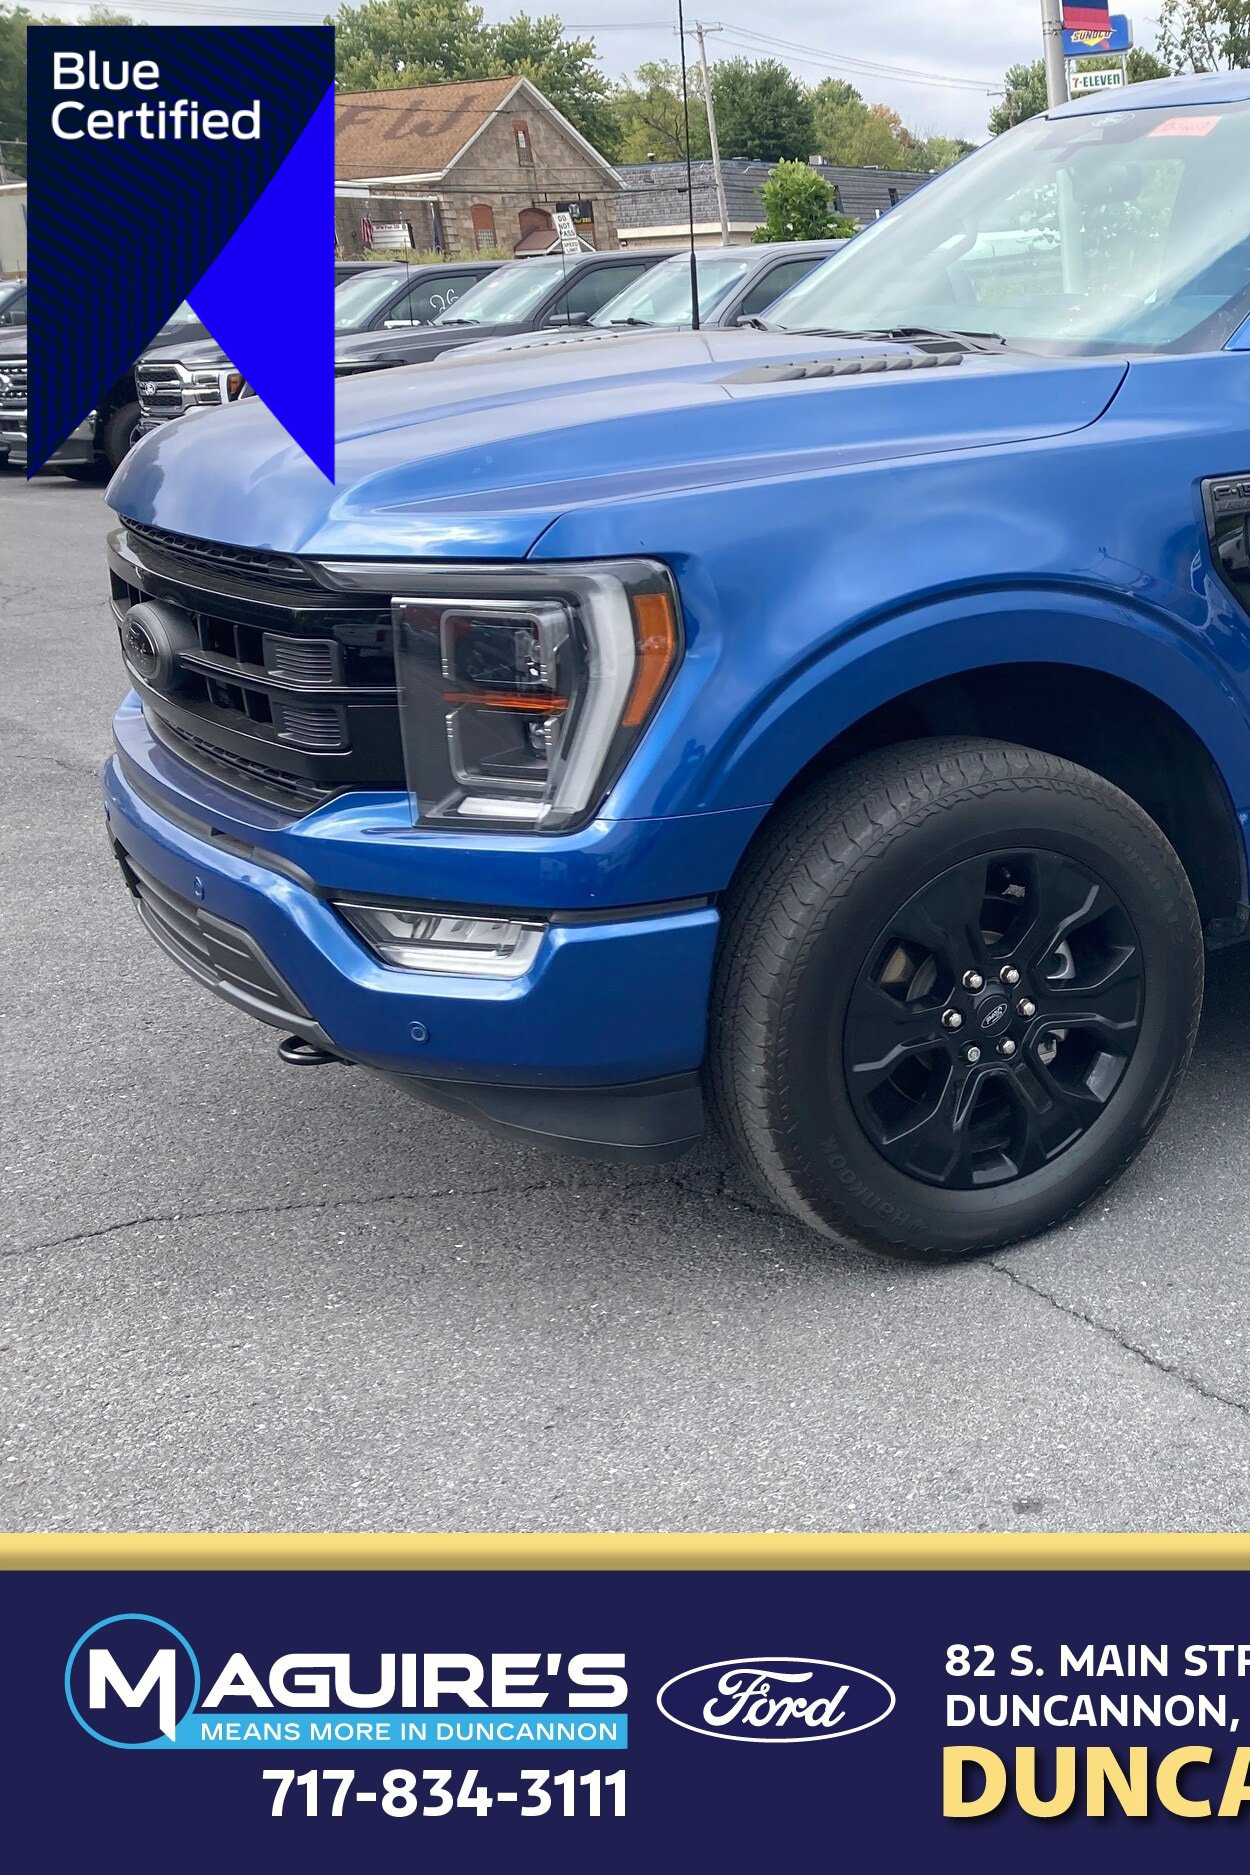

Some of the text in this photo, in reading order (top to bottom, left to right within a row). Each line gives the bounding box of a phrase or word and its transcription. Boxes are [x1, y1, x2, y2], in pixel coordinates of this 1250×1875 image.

[1073, 29, 1111, 41] SUNOCO
[558, 214, 567, 222] DO
[558, 222, 570, 230] NOT
[560, 230, 576, 238] ASS
